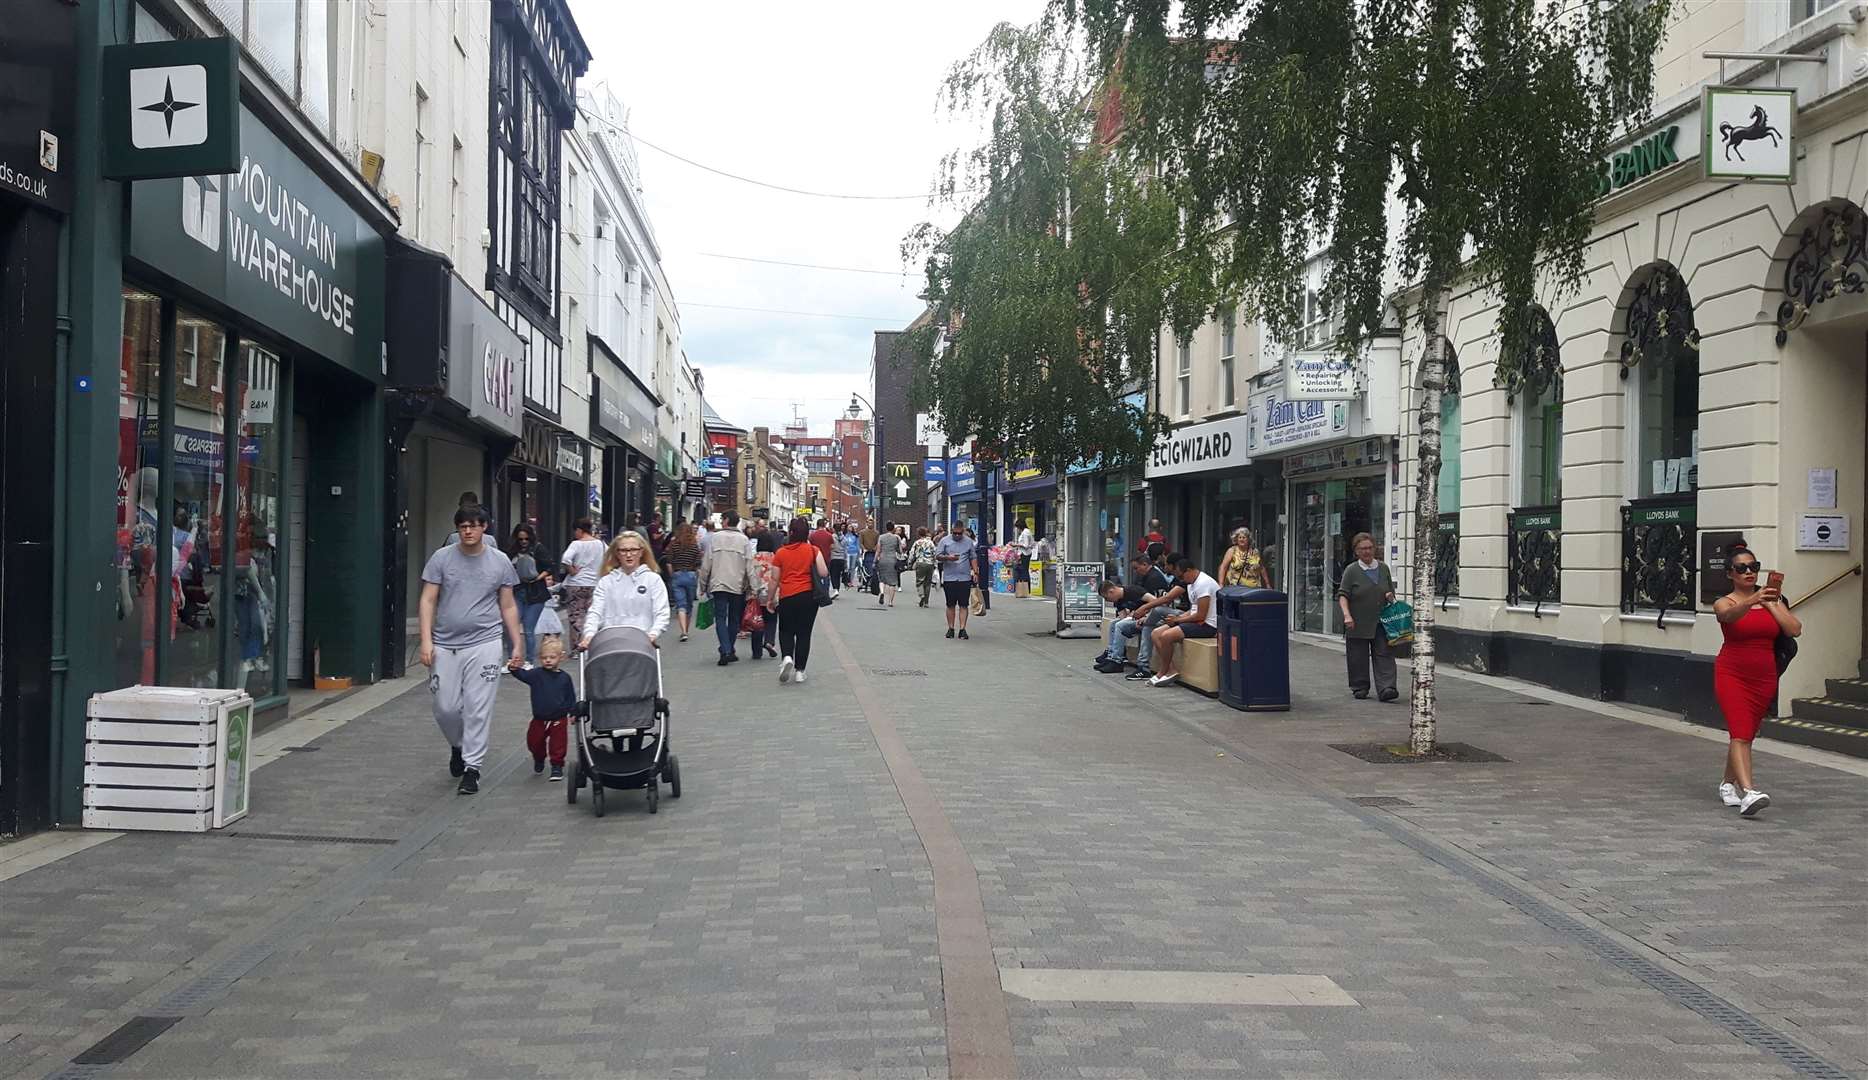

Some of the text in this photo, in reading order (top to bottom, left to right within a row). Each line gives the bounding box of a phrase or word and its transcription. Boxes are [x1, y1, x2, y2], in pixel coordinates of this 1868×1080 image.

[1613, 125, 1680, 189] BANK
[231, 155, 336, 270] MOUNTAIN
[229, 210, 354, 335] WAREHOUSE
[1295, 360, 1322, 371] Zam
[1266, 395, 1295, 431] Zam
[1154, 432, 1231, 467] ECIGWIZARD
[1525, 517, 1551, 526] LLOYDS BANK
[1646, 510, 1680, 520] LLOYDS BANK
